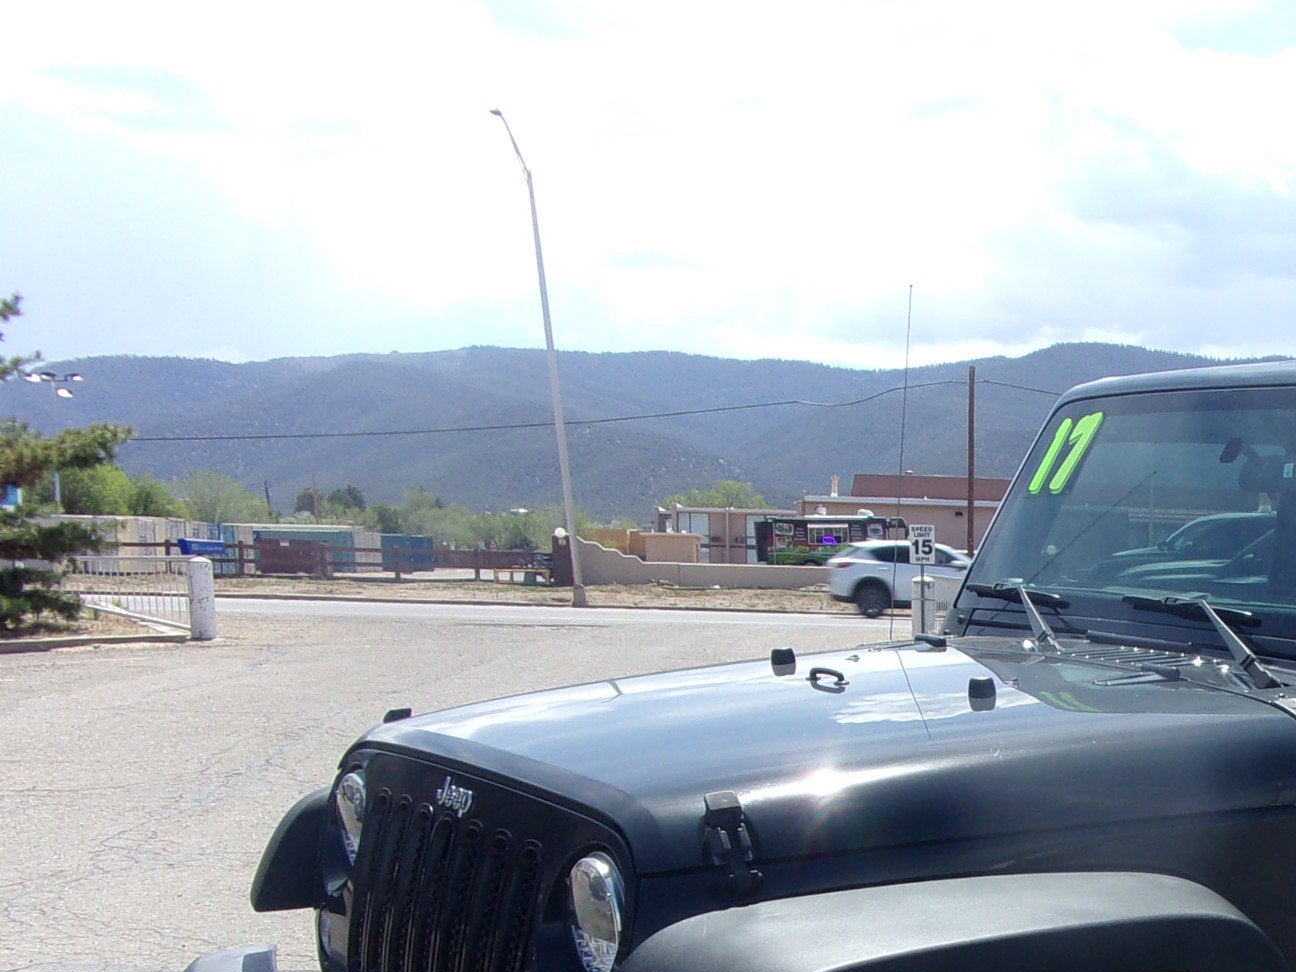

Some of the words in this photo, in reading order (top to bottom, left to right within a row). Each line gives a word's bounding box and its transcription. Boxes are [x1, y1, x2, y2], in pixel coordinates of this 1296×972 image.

[1028, 411, 1104, 495] 17
[912, 539, 933, 555] 15
[436, 776, 473, 818] Jeep
